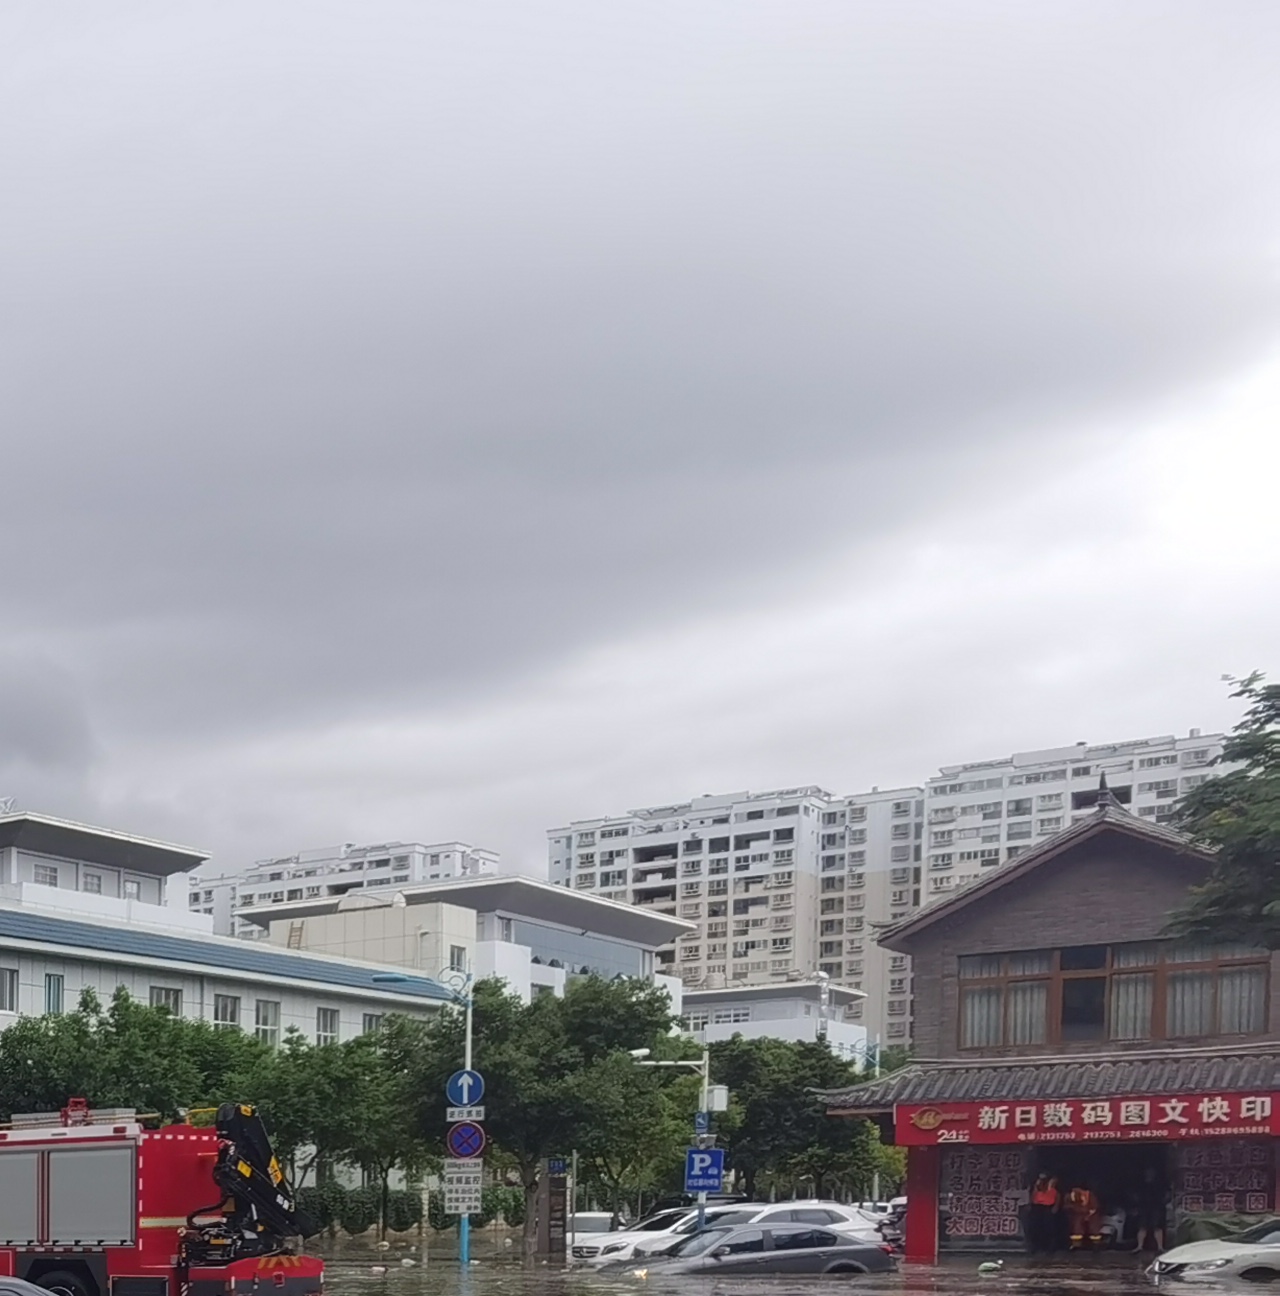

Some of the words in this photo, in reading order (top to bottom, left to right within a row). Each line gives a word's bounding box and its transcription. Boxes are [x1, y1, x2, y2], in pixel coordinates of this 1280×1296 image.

[977, 1096, 1272, 1130] 新日数码图文快印
[691, 1154, 712, 1175] P
[945, 1216, 1019, 1235] 大图复印
